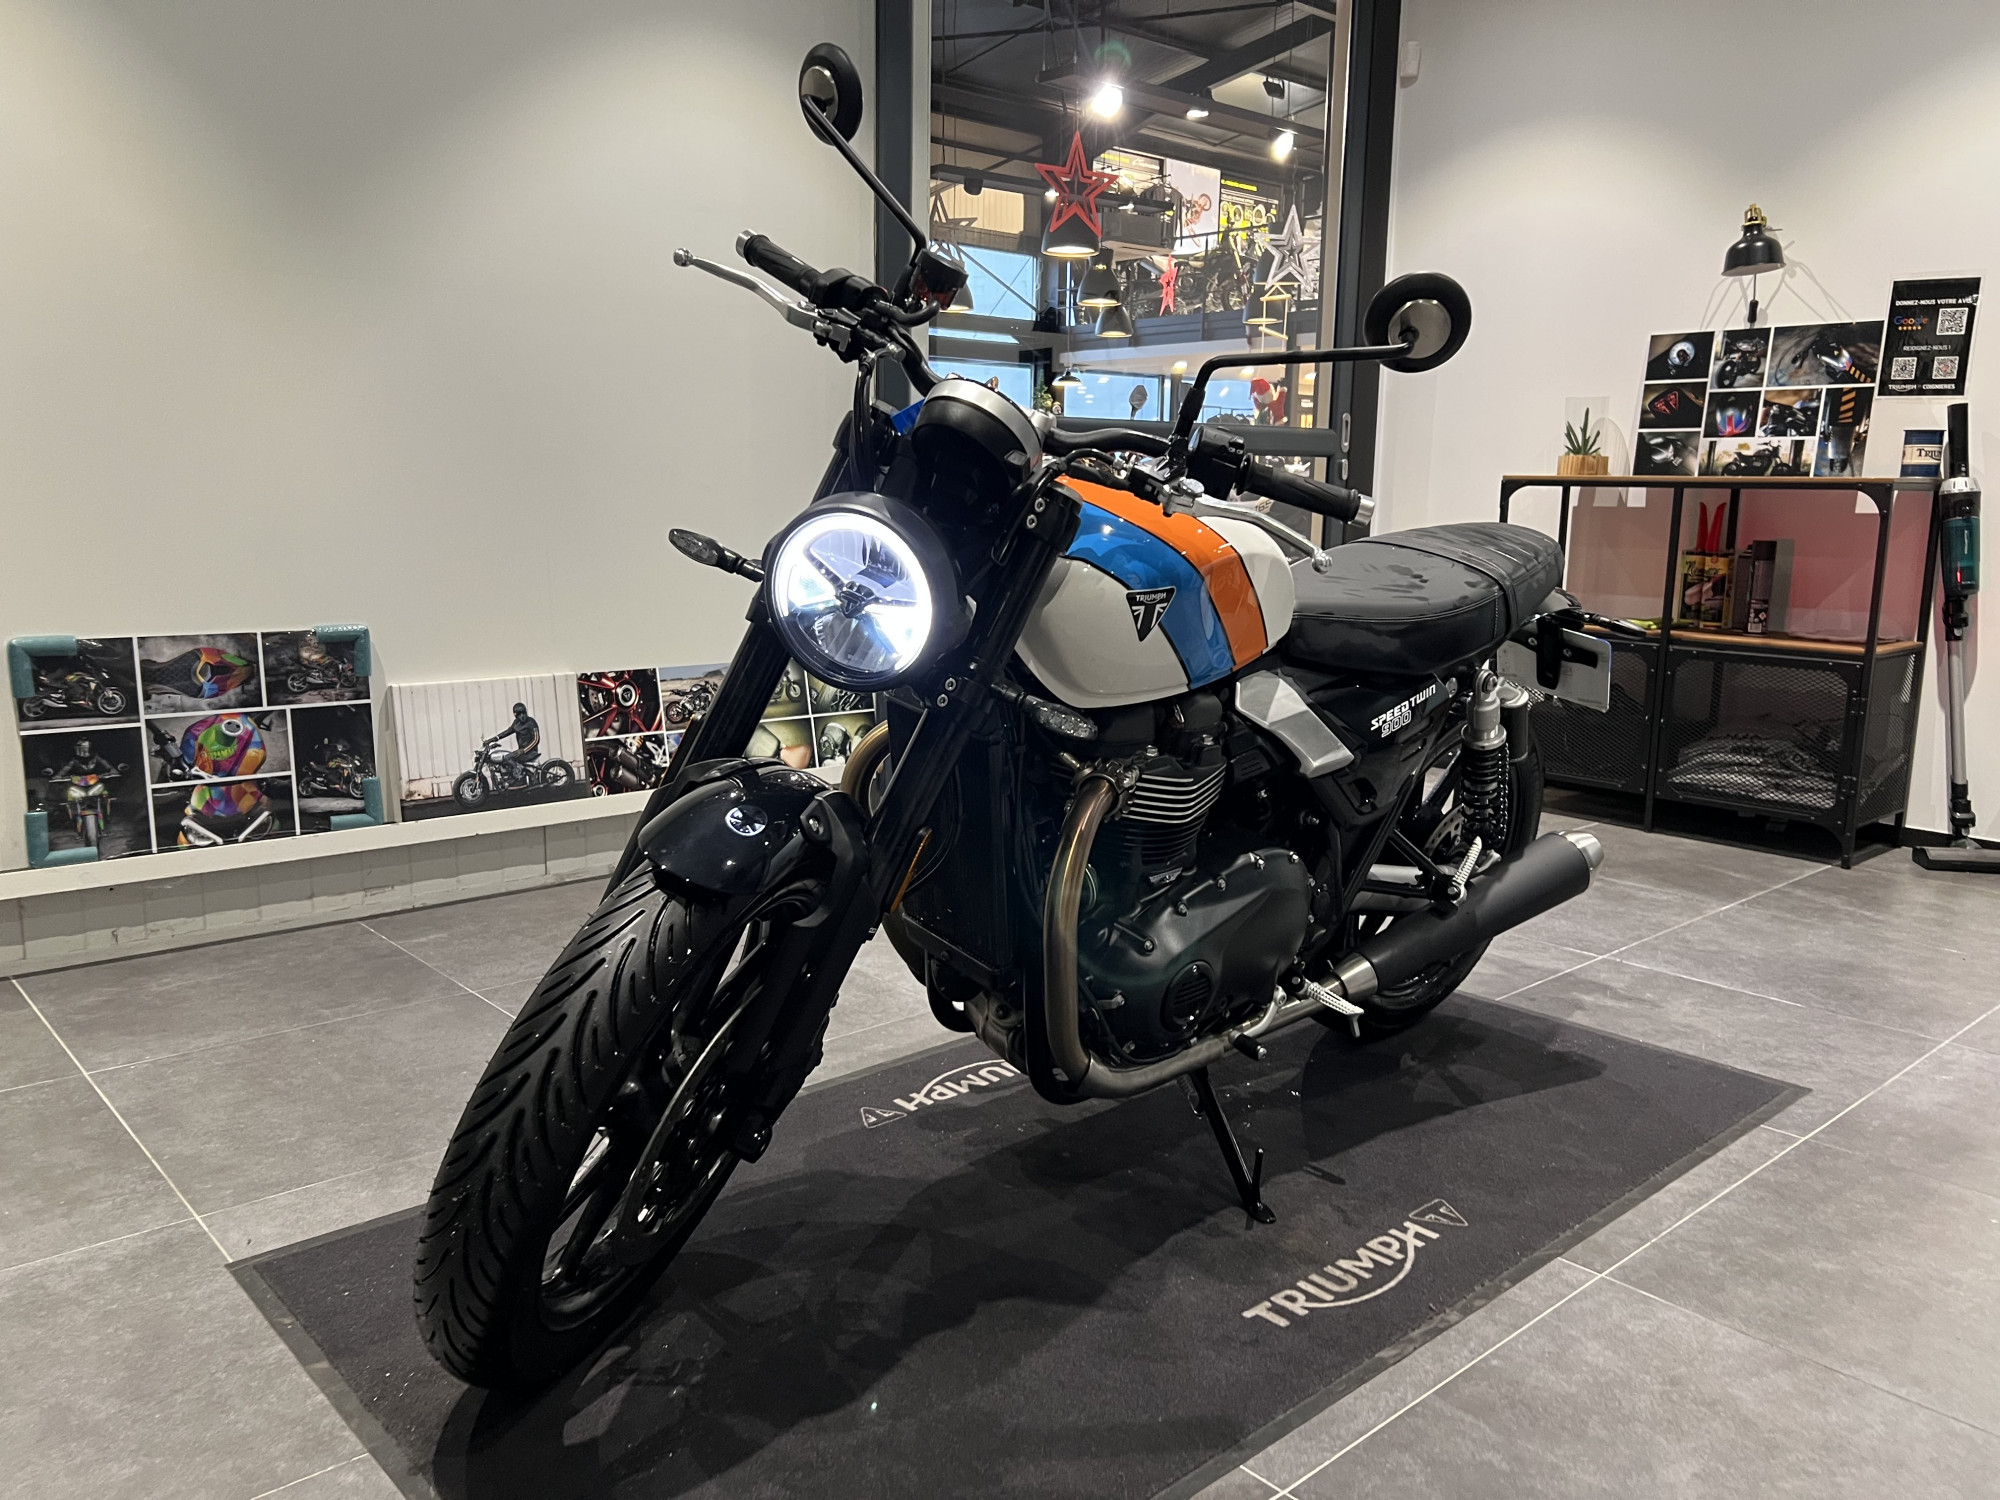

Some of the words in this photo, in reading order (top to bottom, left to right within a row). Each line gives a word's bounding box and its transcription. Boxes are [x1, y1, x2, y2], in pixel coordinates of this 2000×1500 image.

[1894, 315, 1929, 326] Google
[1135, 592, 1167, 603] TRIUMPH
[1371, 700, 1410, 731] SPEED
[1410, 684, 1436, 707] TWIN
[1381, 709, 1412, 738] 900
[1242, 1221, 1440, 1327] TRIUMPH
